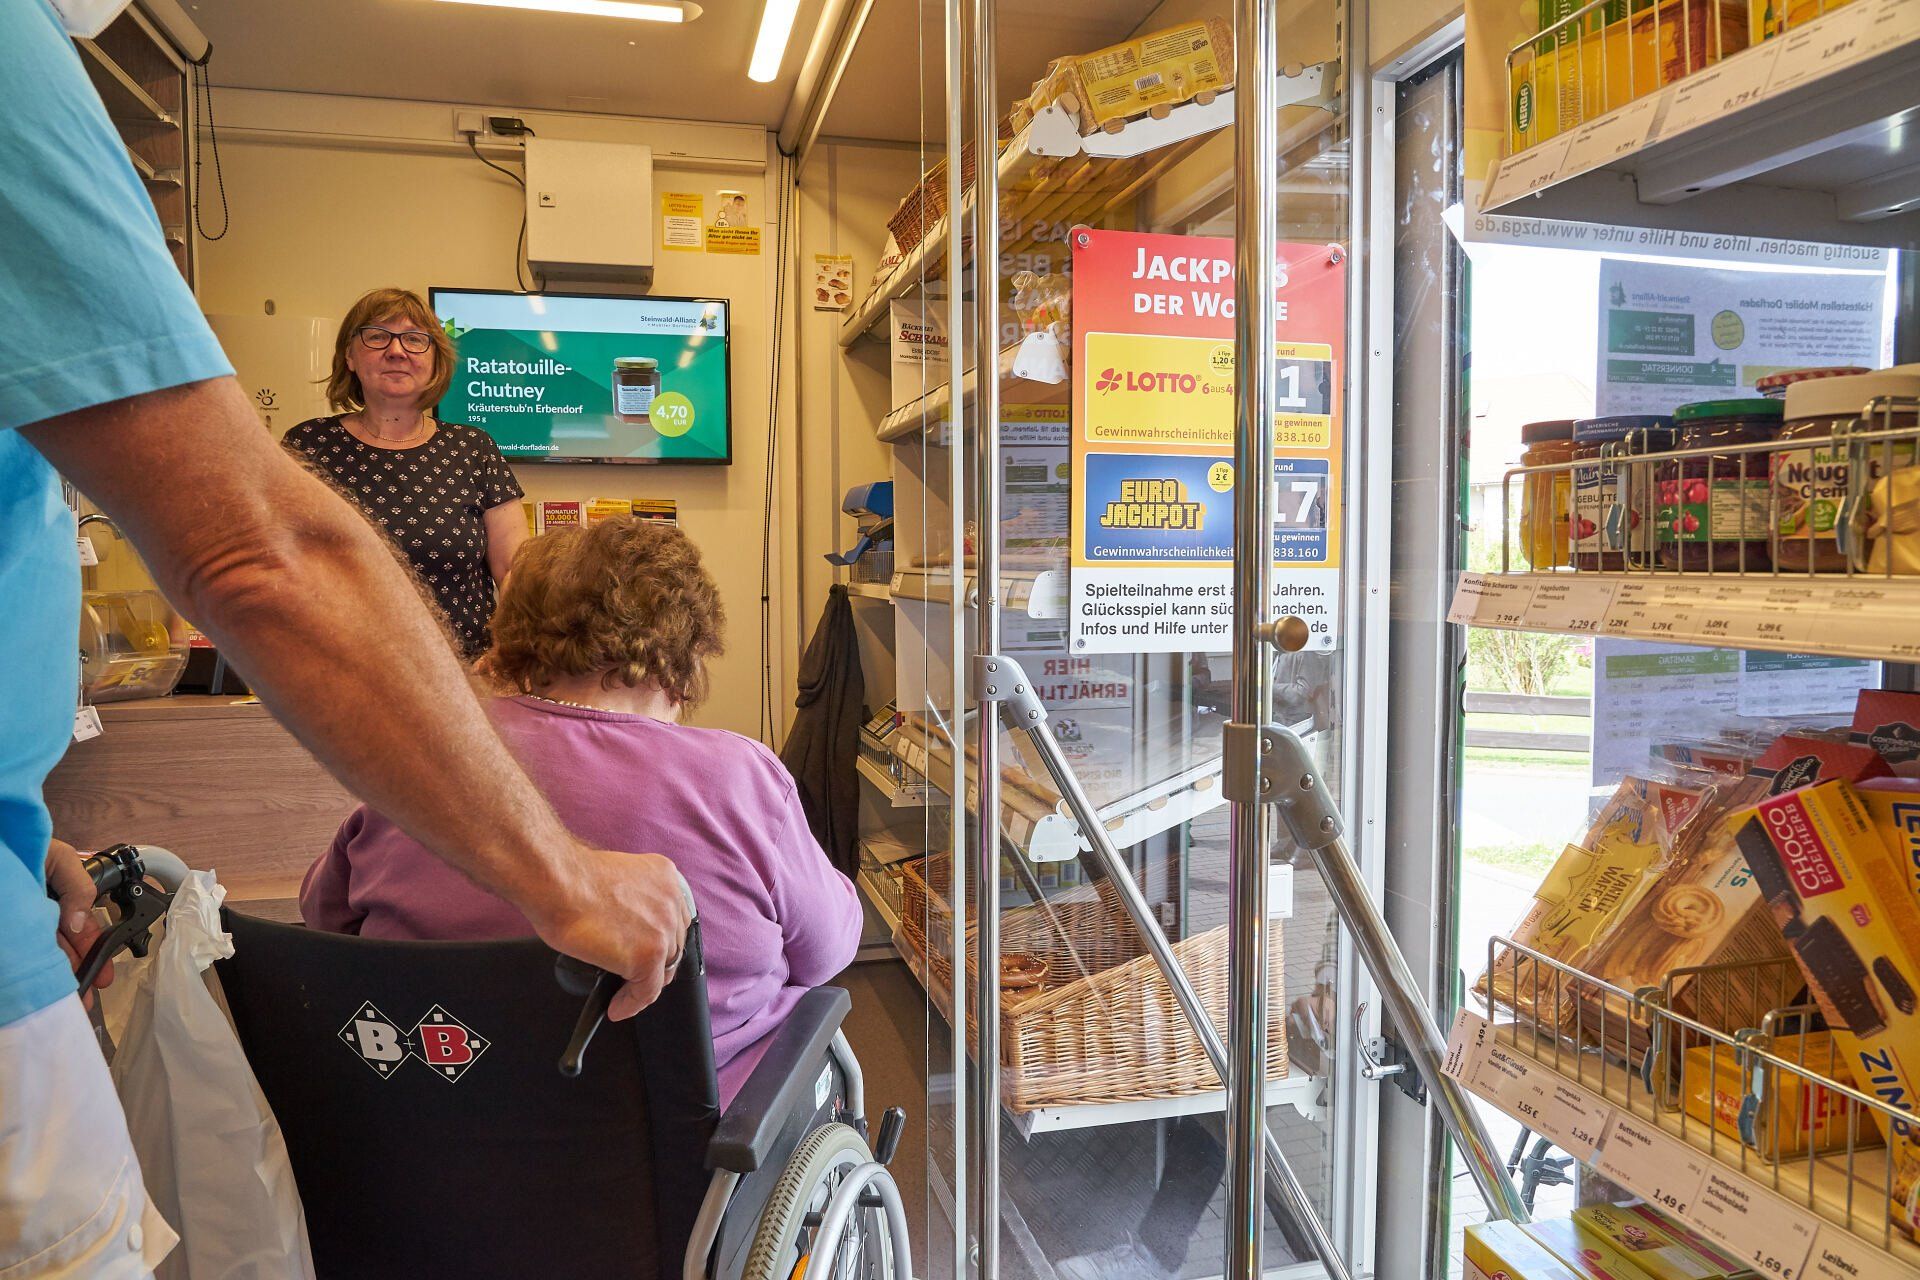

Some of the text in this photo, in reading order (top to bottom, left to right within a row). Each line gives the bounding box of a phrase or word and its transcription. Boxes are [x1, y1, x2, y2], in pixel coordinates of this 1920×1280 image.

[1519, 87, 1529, 129] HERBA
[1529, 174, 1549, 189] 0,79
[1132, 247, 1289, 289] JACKPS
[1133, 291, 1288, 321] DER WOE
[898, 330, 949, 344] SCHRAM
[1276, 347, 1296, 357] rund
[467, 357, 573, 375] Ratatouille-
[1212, 356, 1229, 366] 1,20
[467, 381, 545, 401] Chutney
[535, 404, 584, 414] Erbendorf
[656, 405, 688, 419] 4,70
[673, 418, 687, 427] EUR
[1284, 419, 1323, 428] gewinnen
[497, 443, 560, 452] inwald-dorfladen.de
[1275, 463, 1294, 472] rund
[1788, 460, 1881, 486] Nougt
[1121, 479, 1179, 503] EURO
[1800, 485, 1848, 498] Crem
[1100, 502, 1200, 529] JACKPOT
[1281, 533, 1320, 543] gewinnen
[1085, 583, 1193, 598] Spielteilnahme
[1198, 584, 1226, 596] erst
[1272, 584, 1325, 596] Jahren.
[1463, 578, 1518, 590] Konfitüre Schwartau
[1539, 584, 1570, 592] Hagebutten
[1082, 602, 1167, 618] Glücksspiel
[1172, 603, 1207, 615] kann
[1081, 621, 1229, 636] Infos und Hilfe unter
[1568, 619, 1589, 630] 2,29
[1608, 619, 1624, 628] 2,29
[1651, 622, 1667, 631] 1,79
[1705, 619, 1723, 629] 3,09
[1756, 623, 1775, 632] 1,99
[1768, 808, 1820, 890] CHOCO
[1785, 803, 1834, 885] EDELHERB
[1595, 873, 1636, 915] VANILLE
[355, 1019, 403, 1061] B
[419, 1024, 473, 1065] B
[1475, 1030, 1486, 1048] 1,49
[1445, 1051, 1455, 1071] Original
[1450, 1042, 1463, 1074] Neapolitaner
[1517, 1101, 1532, 1115] 1,55
[1571, 1127, 1588, 1142] 1,29
[1618, 1122, 1652, 1146] Butterkeks
[1711, 1175, 1750, 1202] Butterkeks
[1652, 1188, 1687, 1214] 1,49 €
[1706, 1186, 1748, 1214] Schokolade
[1753, 1250, 1793, 1280] 1,69 €
[1822, 1249, 1859, 1277] Leibniz
